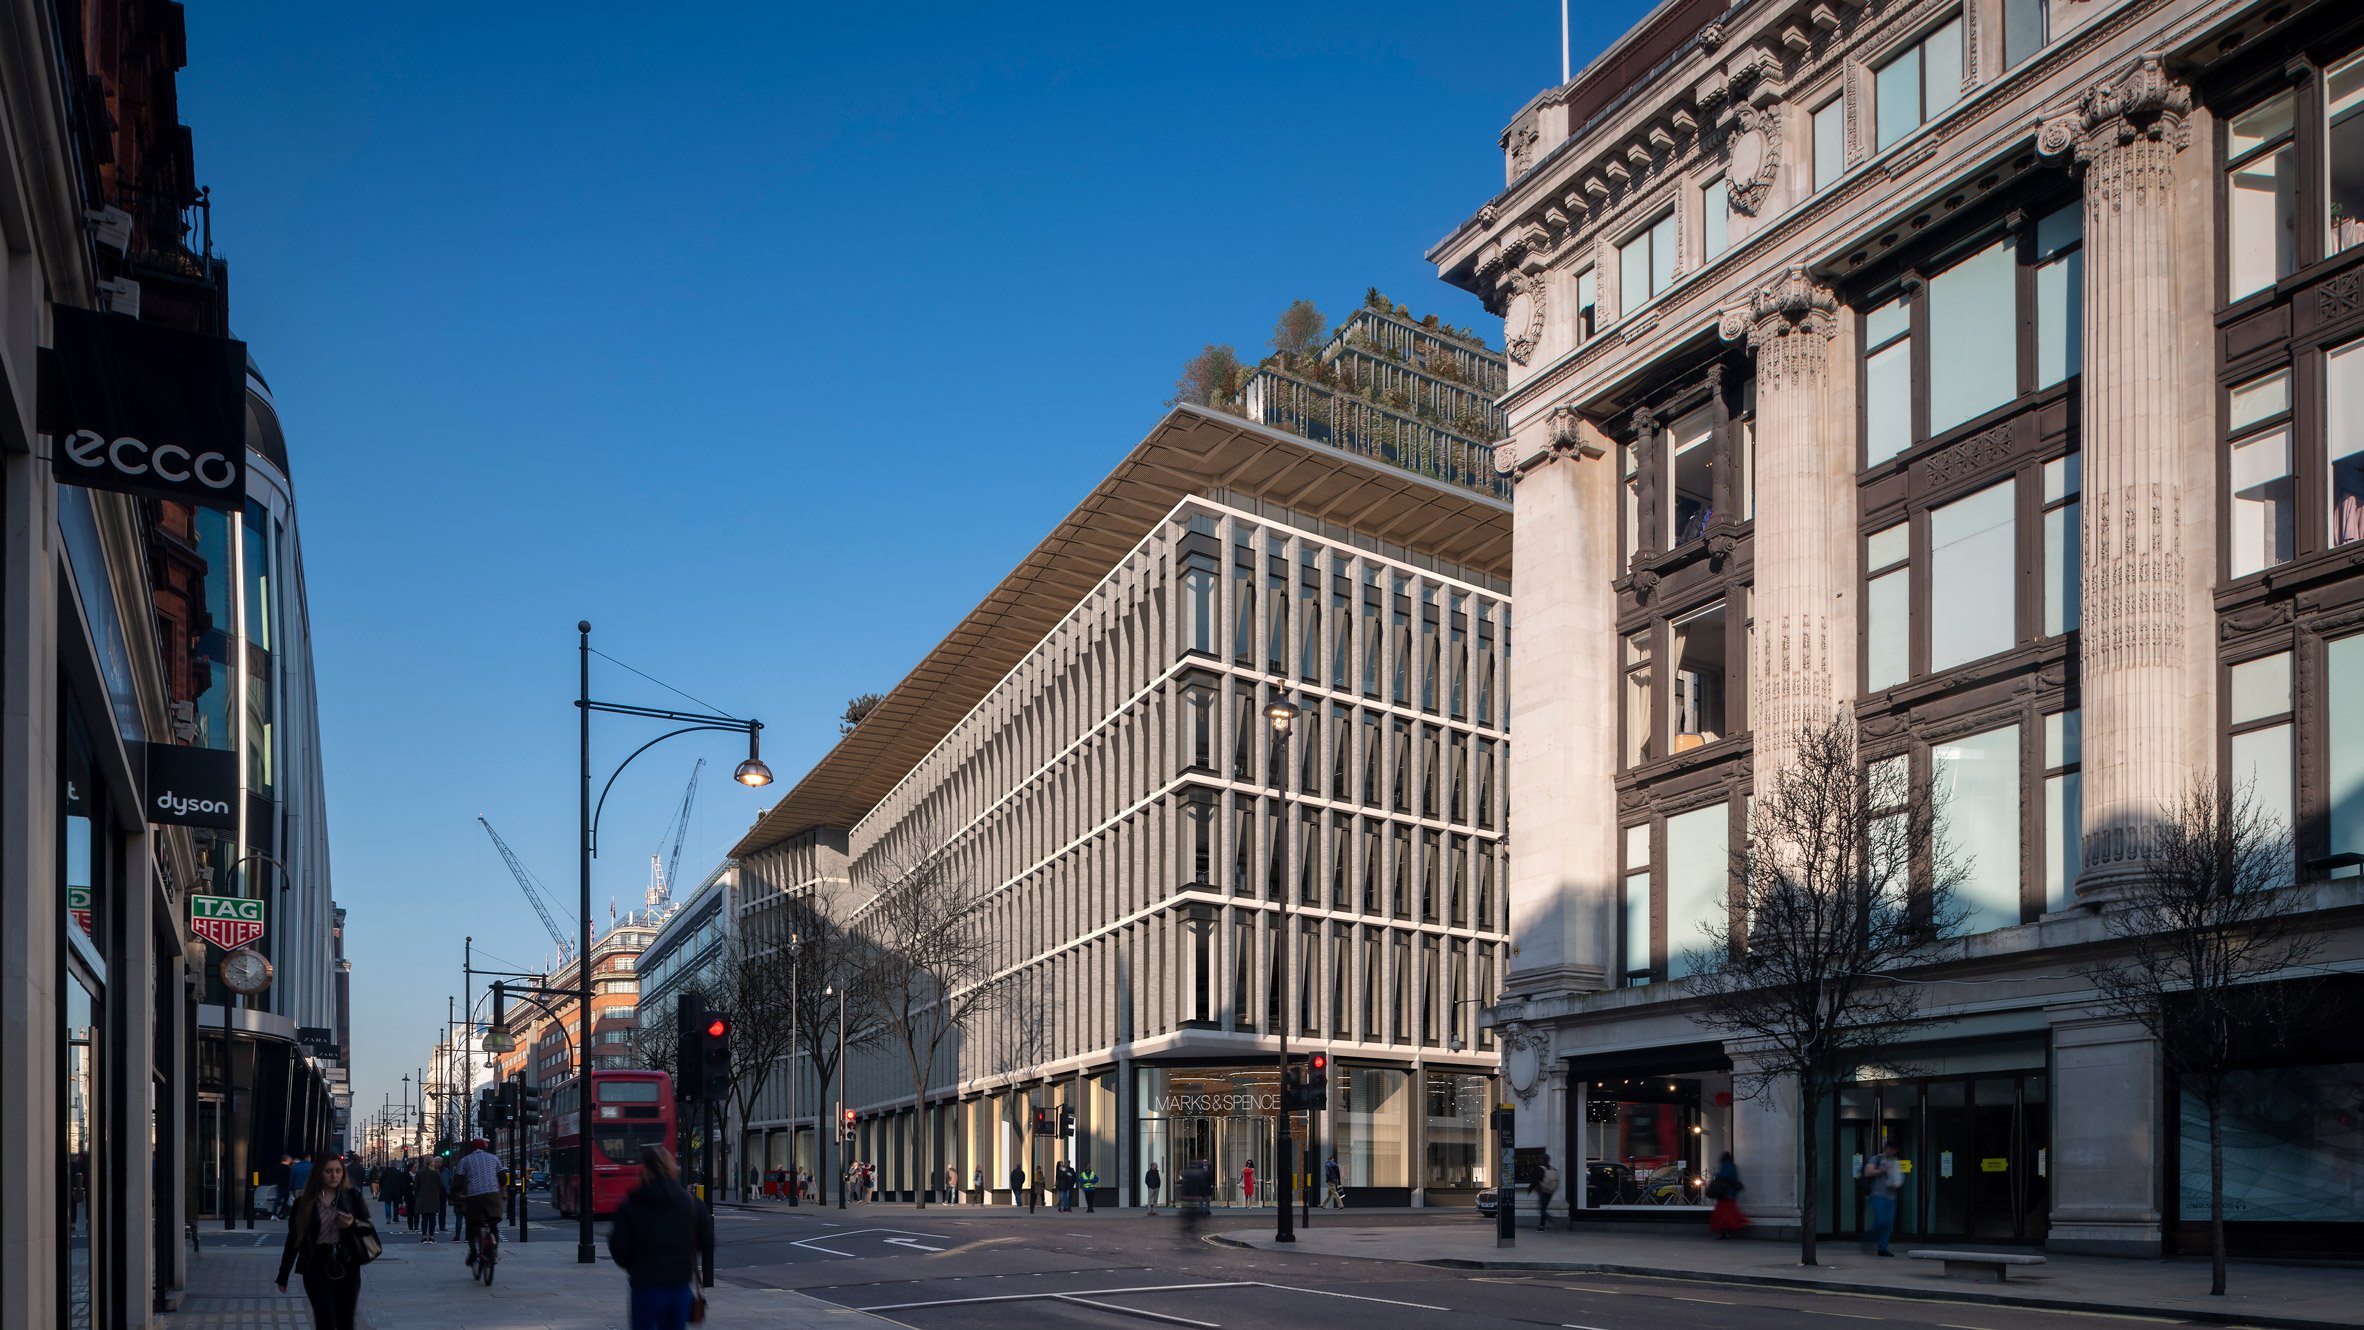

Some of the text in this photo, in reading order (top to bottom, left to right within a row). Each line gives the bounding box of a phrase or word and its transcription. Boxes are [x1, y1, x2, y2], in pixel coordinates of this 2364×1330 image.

[65, 429, 236, 489] ecco
[157, 790, 229, 816] dyson
[197, 898, 258, 919] TAG
[195, 919, 260, 947] HEUER
